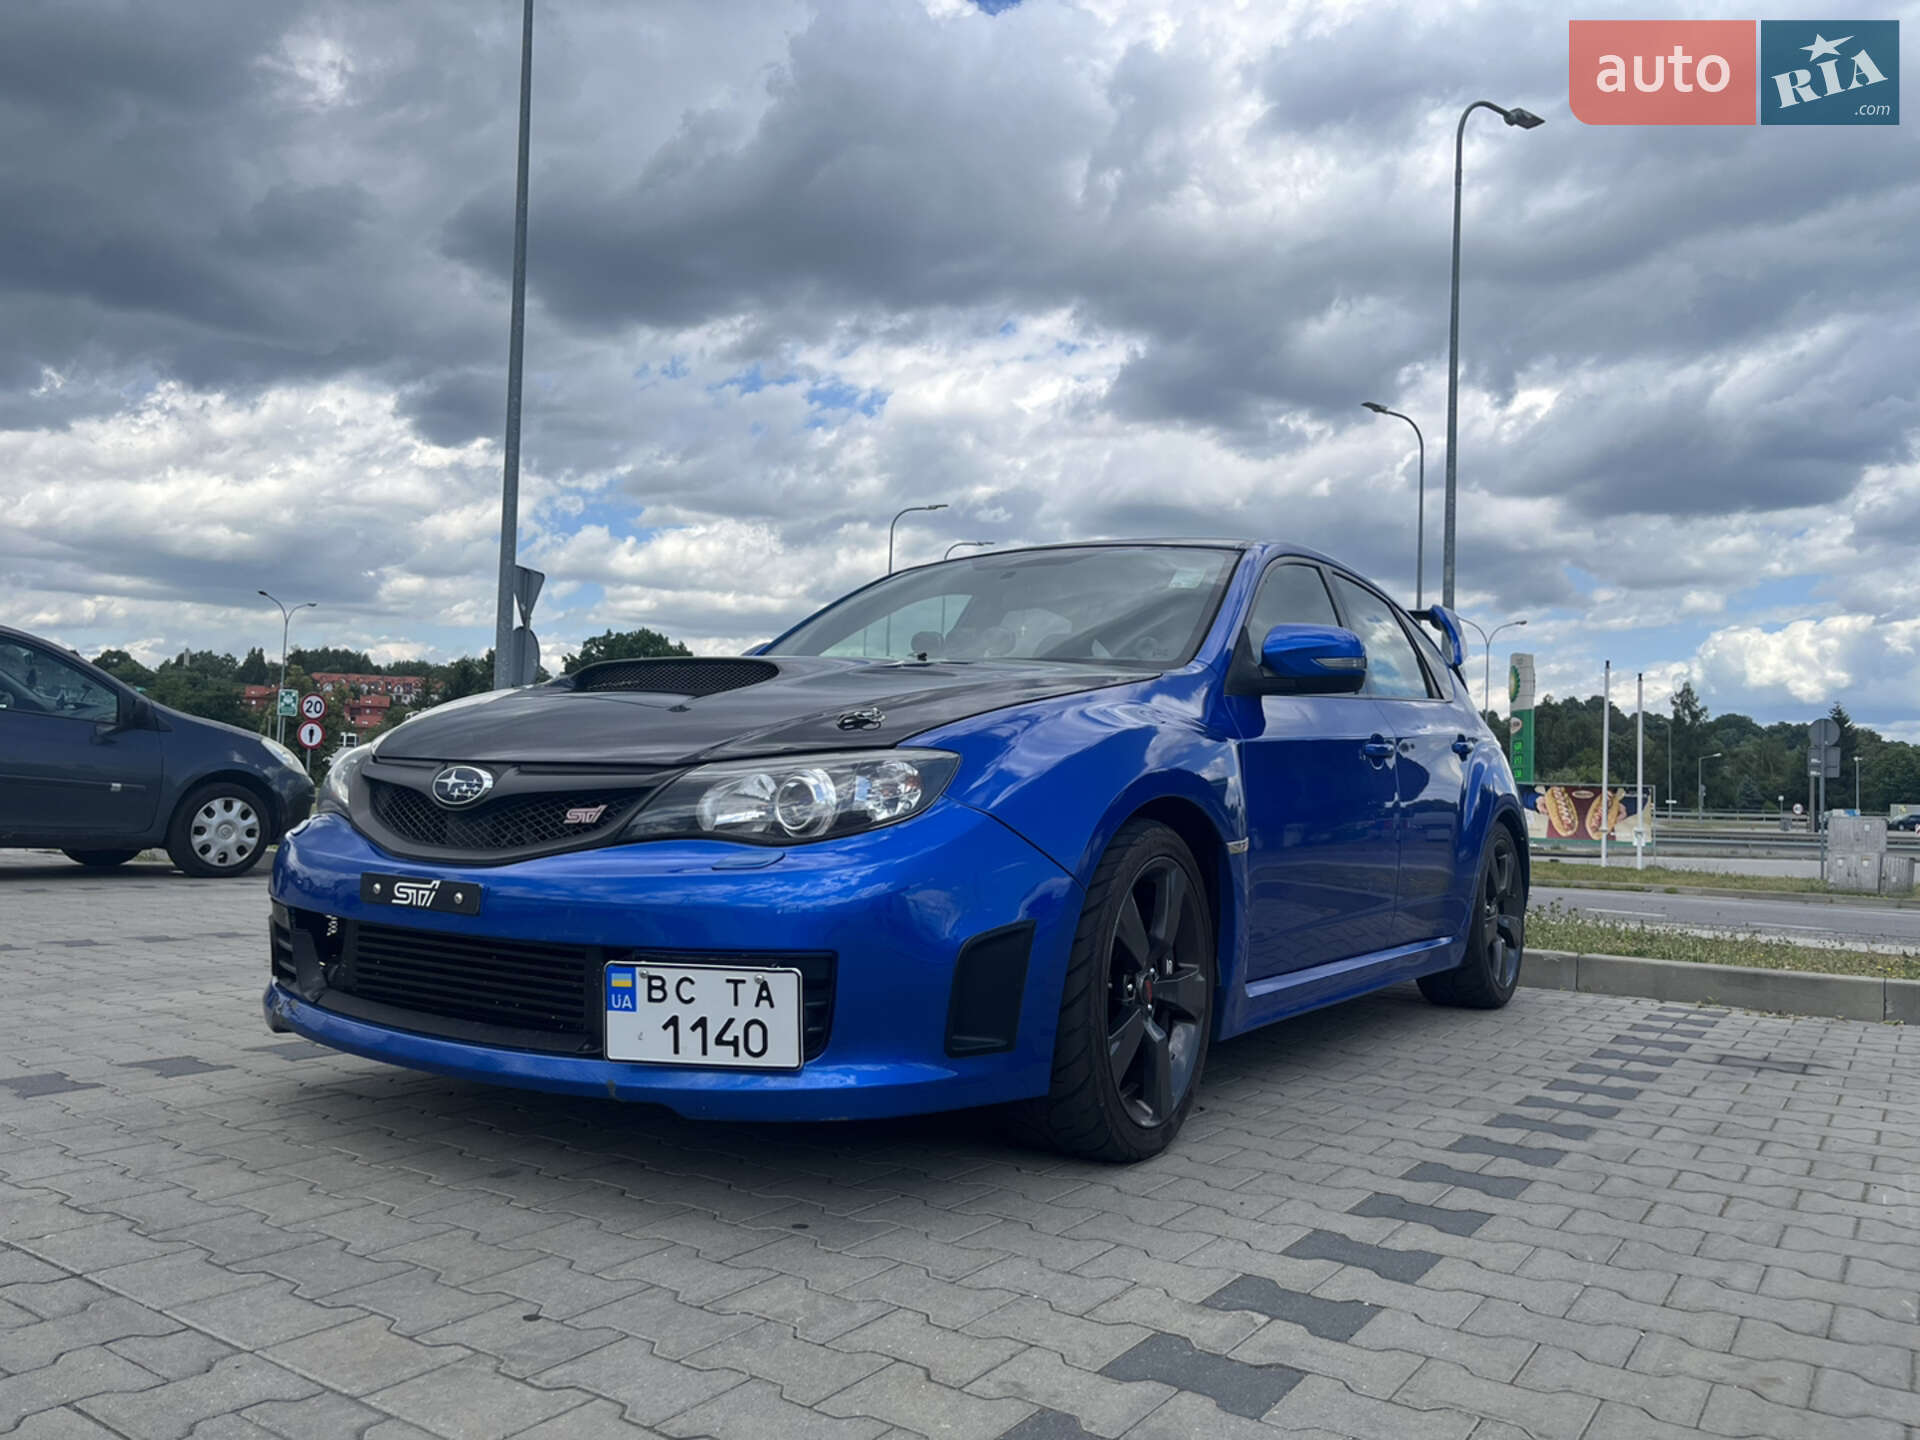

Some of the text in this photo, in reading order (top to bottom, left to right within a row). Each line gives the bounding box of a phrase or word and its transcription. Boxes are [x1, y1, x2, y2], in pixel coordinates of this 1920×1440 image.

[305, 700, 323, 714] 20
[611, 994, 633, 1009] UA
[647, 975, 775, 1009] BC TA
[661, 1015, 769, 1058] 1140
